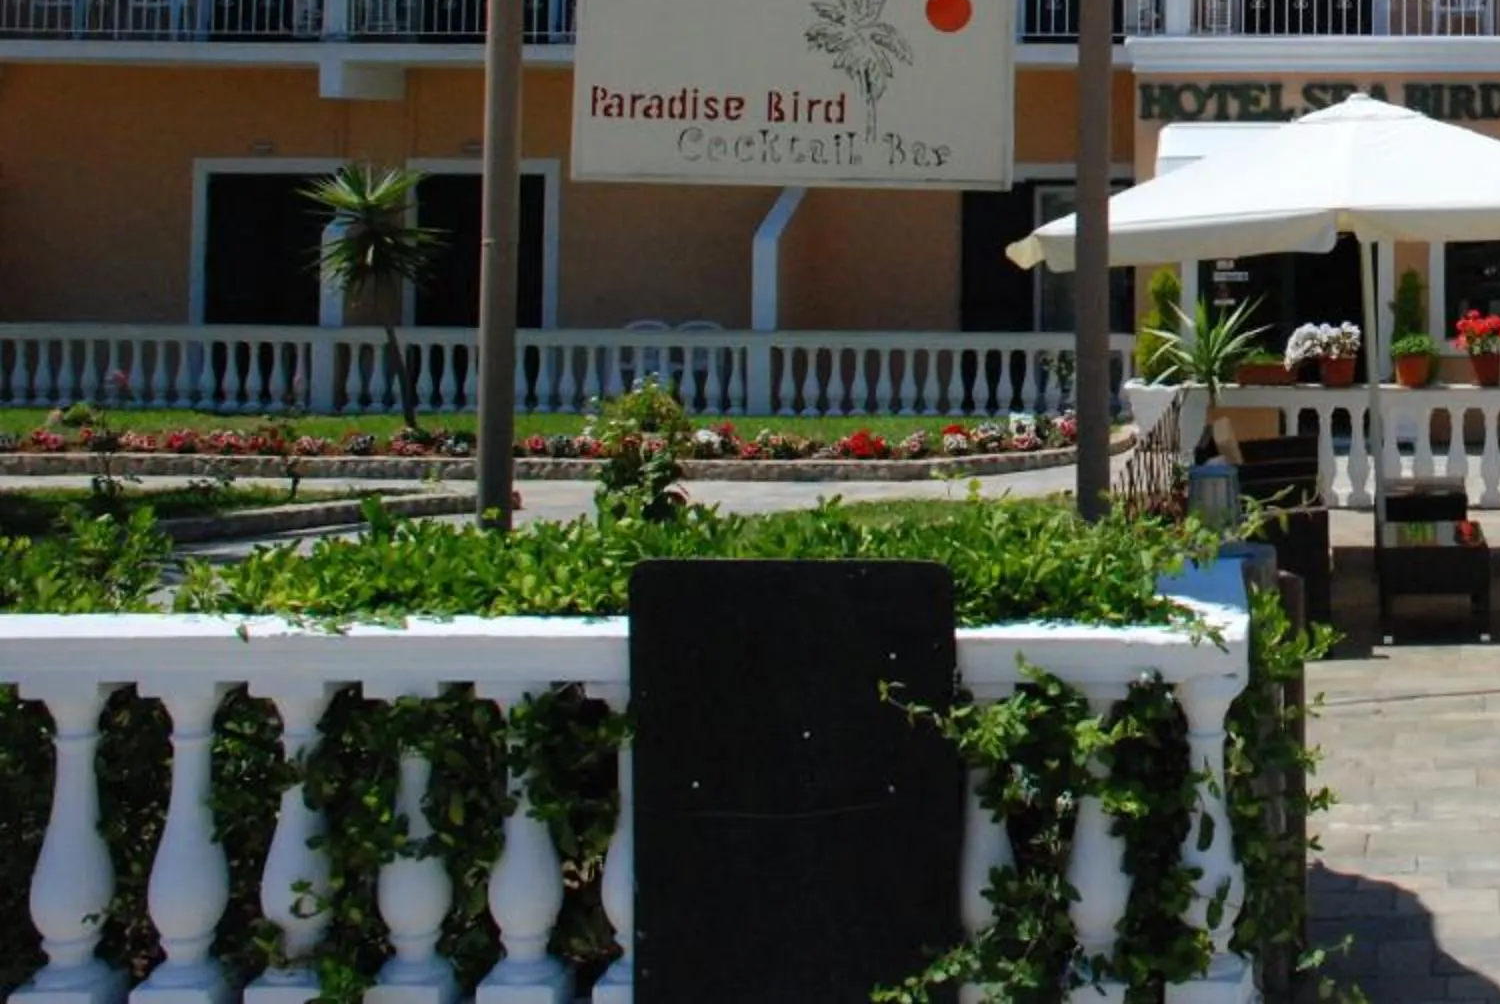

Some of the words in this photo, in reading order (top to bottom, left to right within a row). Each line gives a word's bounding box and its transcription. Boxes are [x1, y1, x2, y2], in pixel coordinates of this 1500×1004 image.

[590, 84, 746, 121] Paradise
[766, 90, 846, 124] Bird
[1138, 82, 1296, 122] HOTEL
[676, 126, 864, 166] Cocktail
[882, 131, 952, 167] Bar
